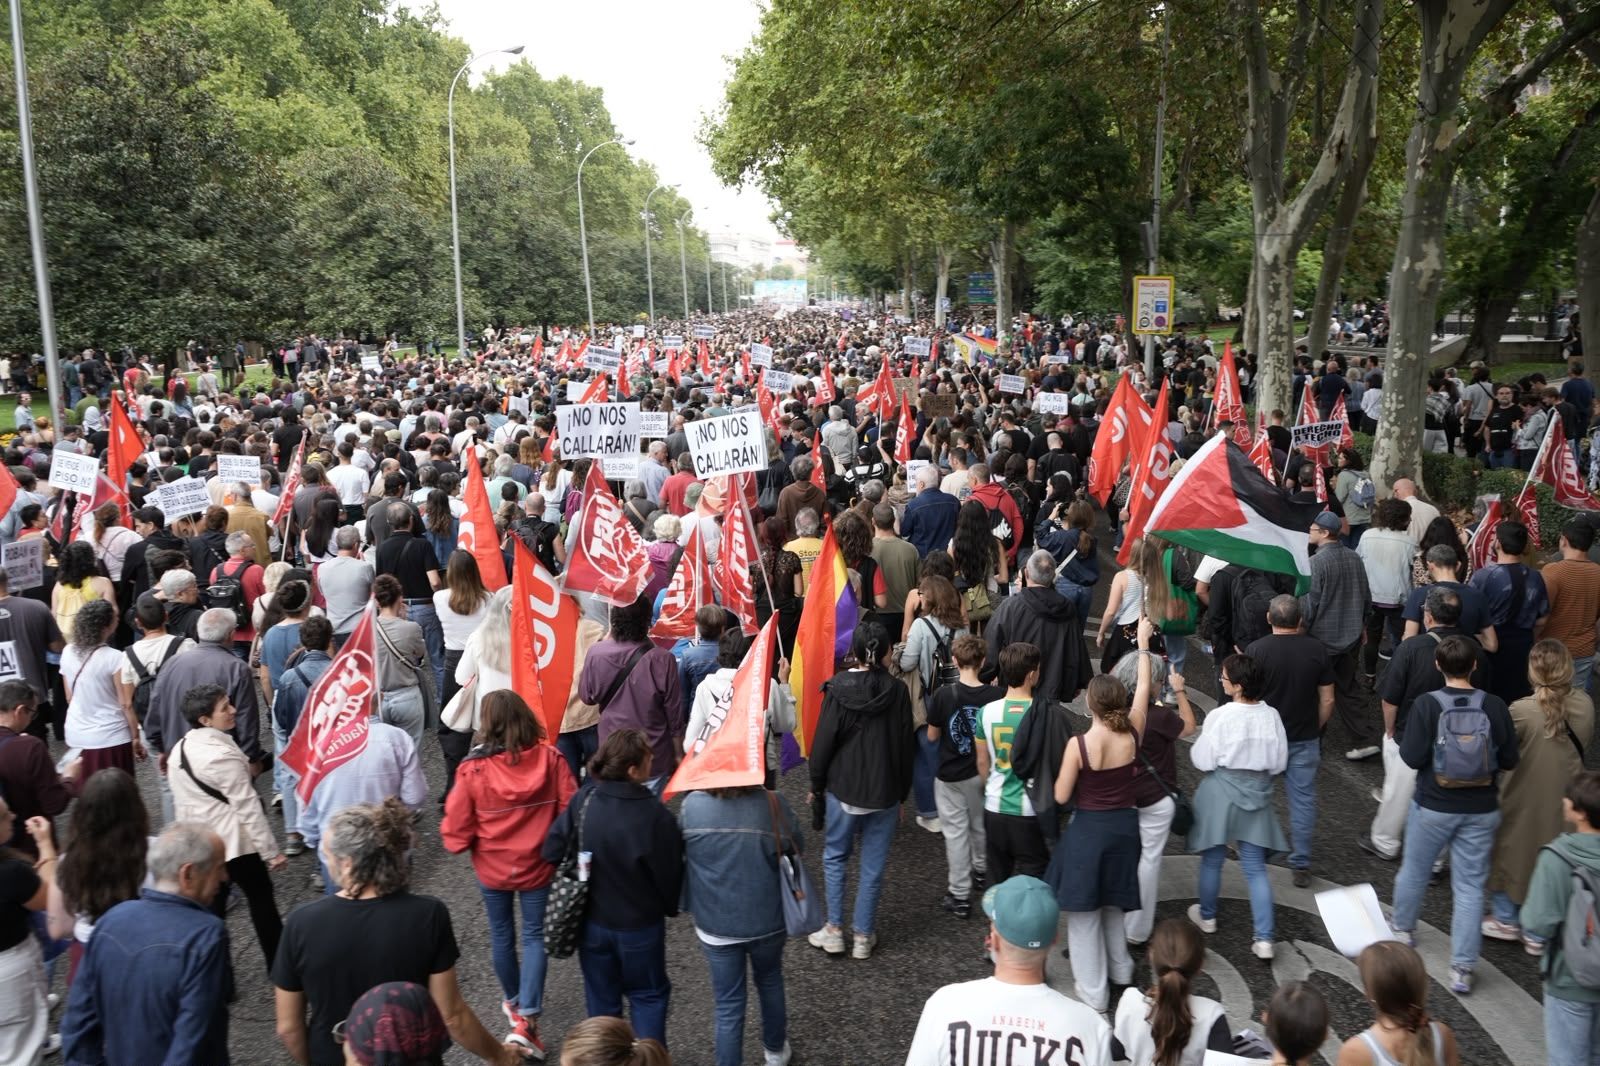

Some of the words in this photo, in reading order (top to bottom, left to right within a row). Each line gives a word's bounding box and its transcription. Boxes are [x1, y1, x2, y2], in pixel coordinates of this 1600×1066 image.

[568, 407, 592, 432] ¡NO
[599, 406, 627, 426] NOS
[1294, 424, 1341, 436] DERECHO
[563, 430, 637, 455] CALLARÁN!
[695, 421, 717, 449] ¡NO
[722, 416, 748, 439] NOS
[1303, 429, 1341, 442] TECHO
[696, 441, 761, 474] CALLARÁN!
[54, 470, 78, 483] PISO
[0, 648, 16, 670] A!
[992, 726, 1013, 769] 5
[992, 1015, 1046, 1031] ANAHEIM
[948, 1021, 1085, 1066] DUCKS
